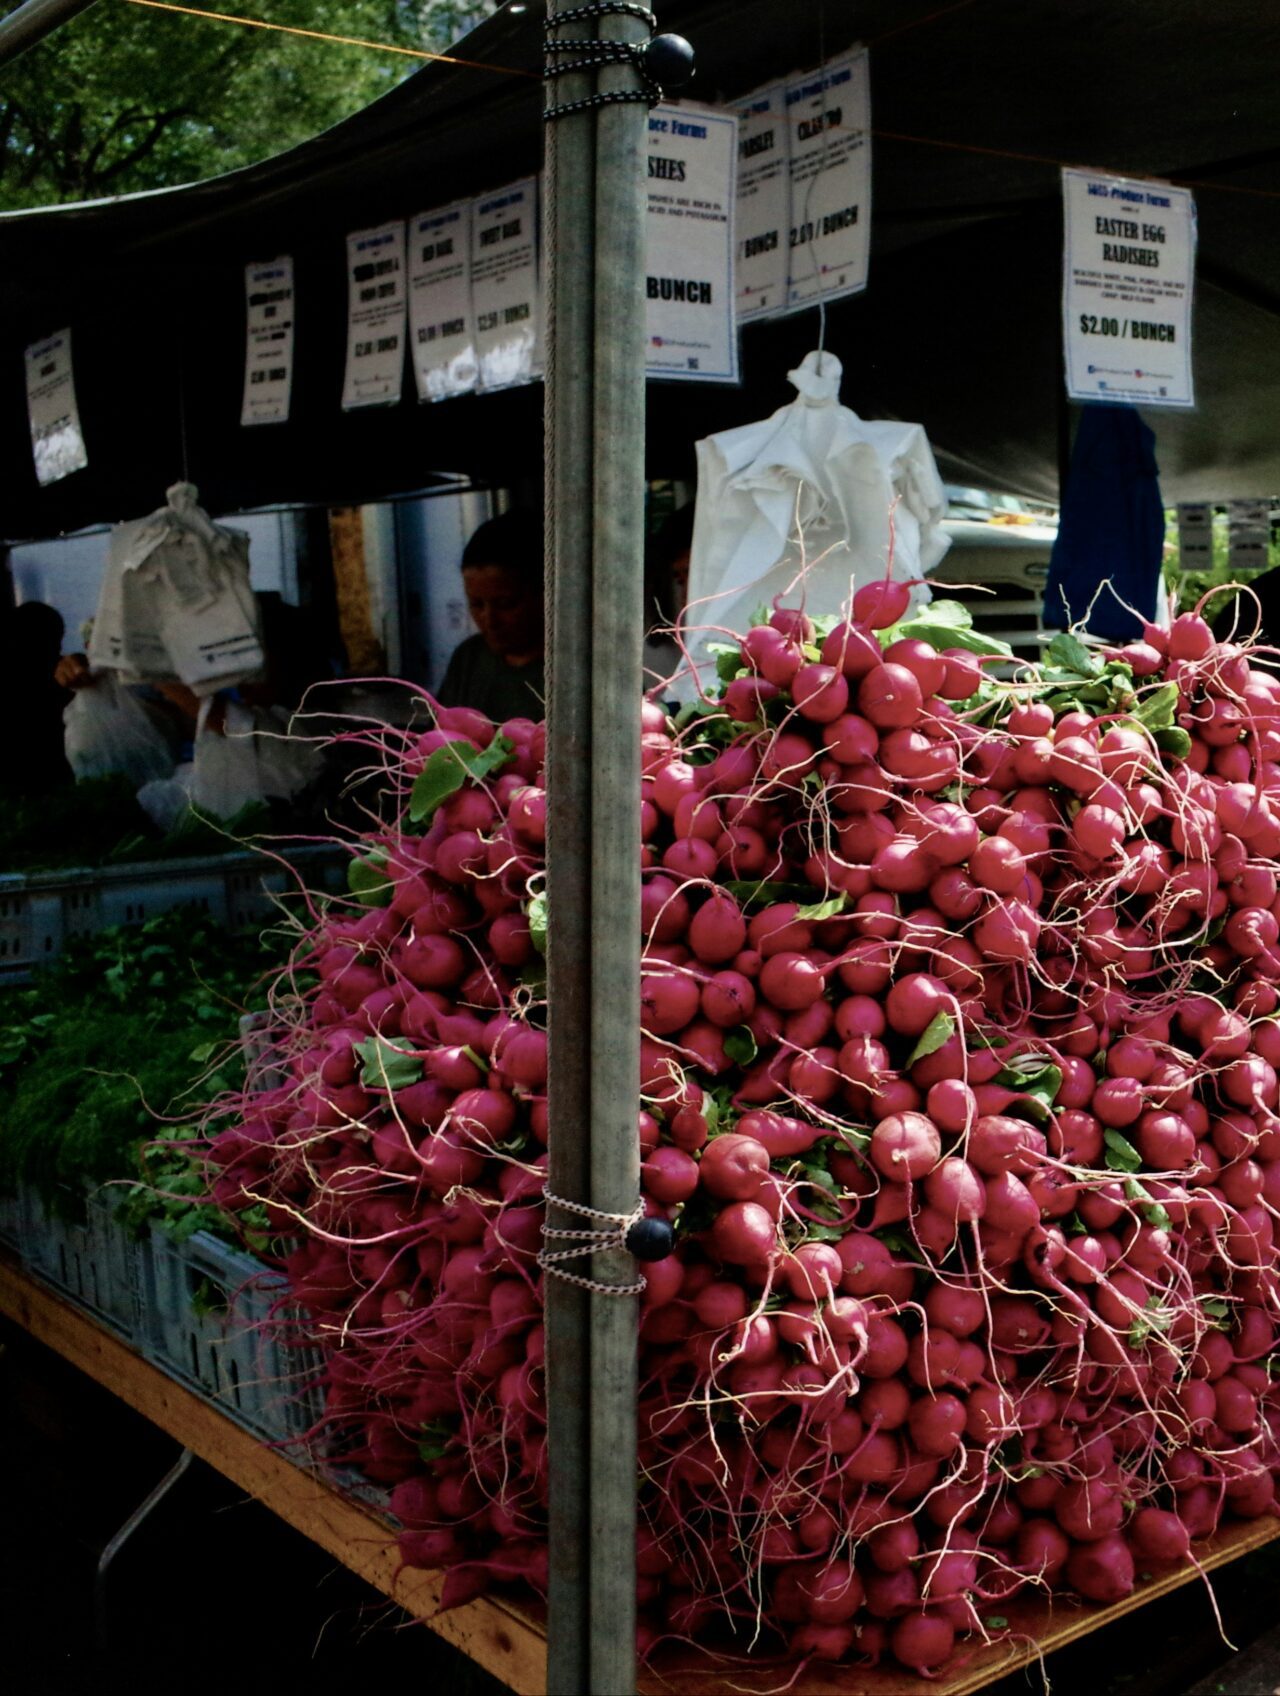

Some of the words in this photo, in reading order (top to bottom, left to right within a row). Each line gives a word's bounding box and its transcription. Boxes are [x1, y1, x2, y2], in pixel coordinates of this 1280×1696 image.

[672, 120, 706, 139] Farms
[823, 204, 858, 235] BUNCH
[1095, 216, 1138, 240] EASTER
[1142, 223, 1166, 244] EGG
[1102, 243, 1159, 268] RADISHES
[646, 276, 711, 304] BUNCH
[1080, 313, 1119, 336] $2.00
[1122, 319, 1128, 338] /
[1131, 320, 1175, 343] BUNCH
